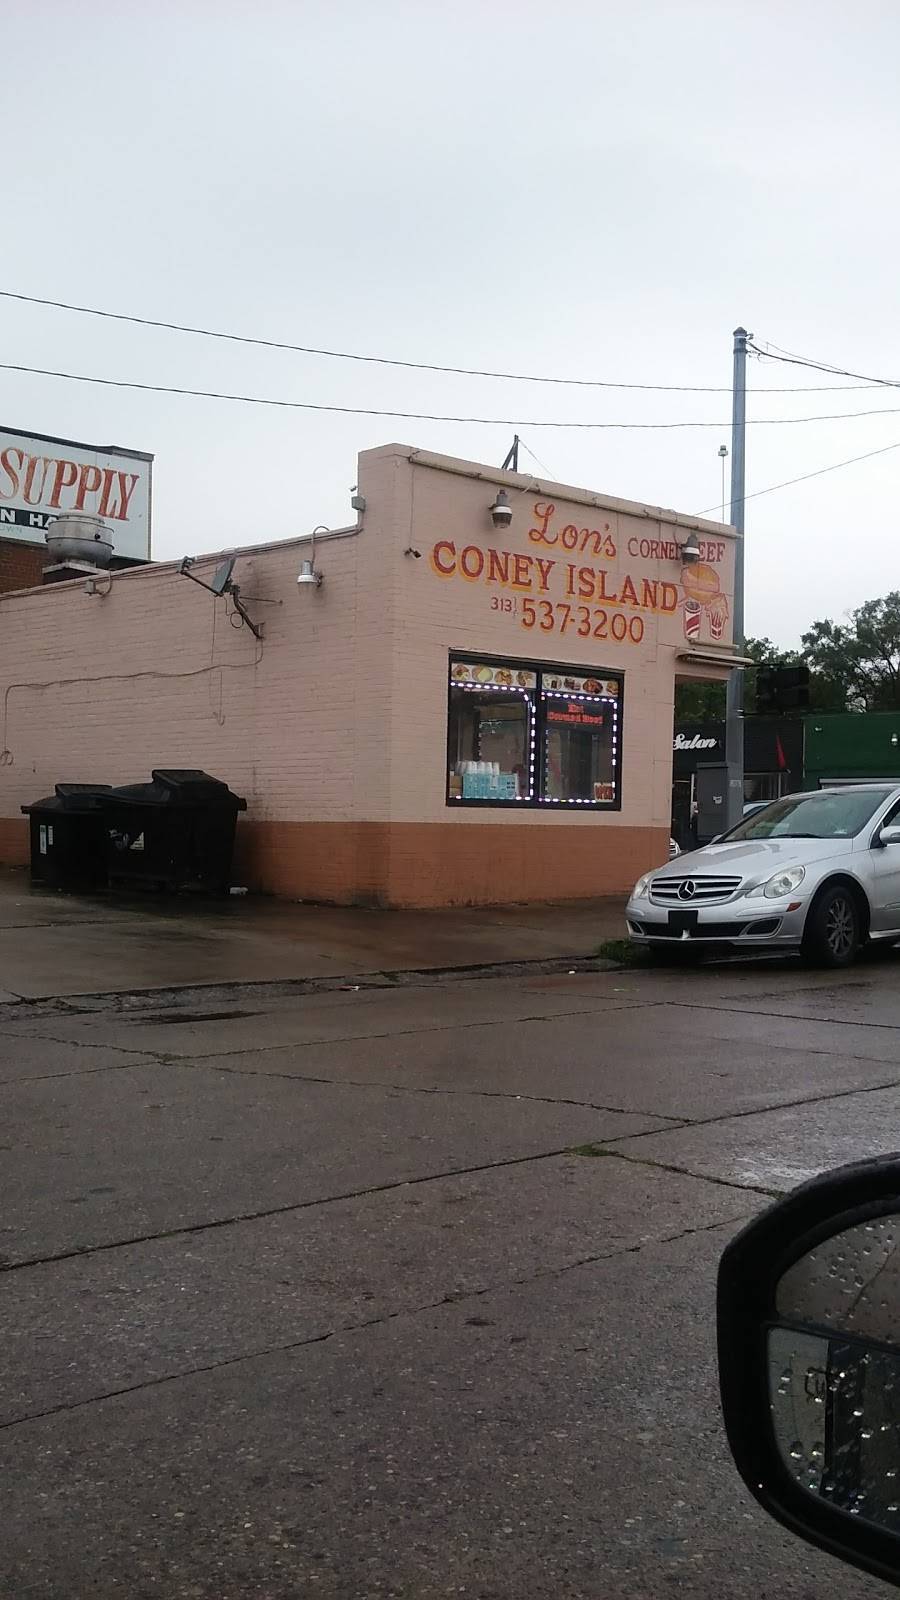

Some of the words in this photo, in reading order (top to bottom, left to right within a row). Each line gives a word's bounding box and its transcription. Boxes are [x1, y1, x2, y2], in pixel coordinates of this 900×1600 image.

[0, 446, 140, 521] SUPPLY
[528, 502, 618, 558] Lon's
[698, 541, 726, 562] EEF
[432, 540, 555, 591] CONEY
[566, 564, 679, 614] ISLAND
[522, 597, 645, 643] 537-3200
[672, 733, 718, 751] Salon
